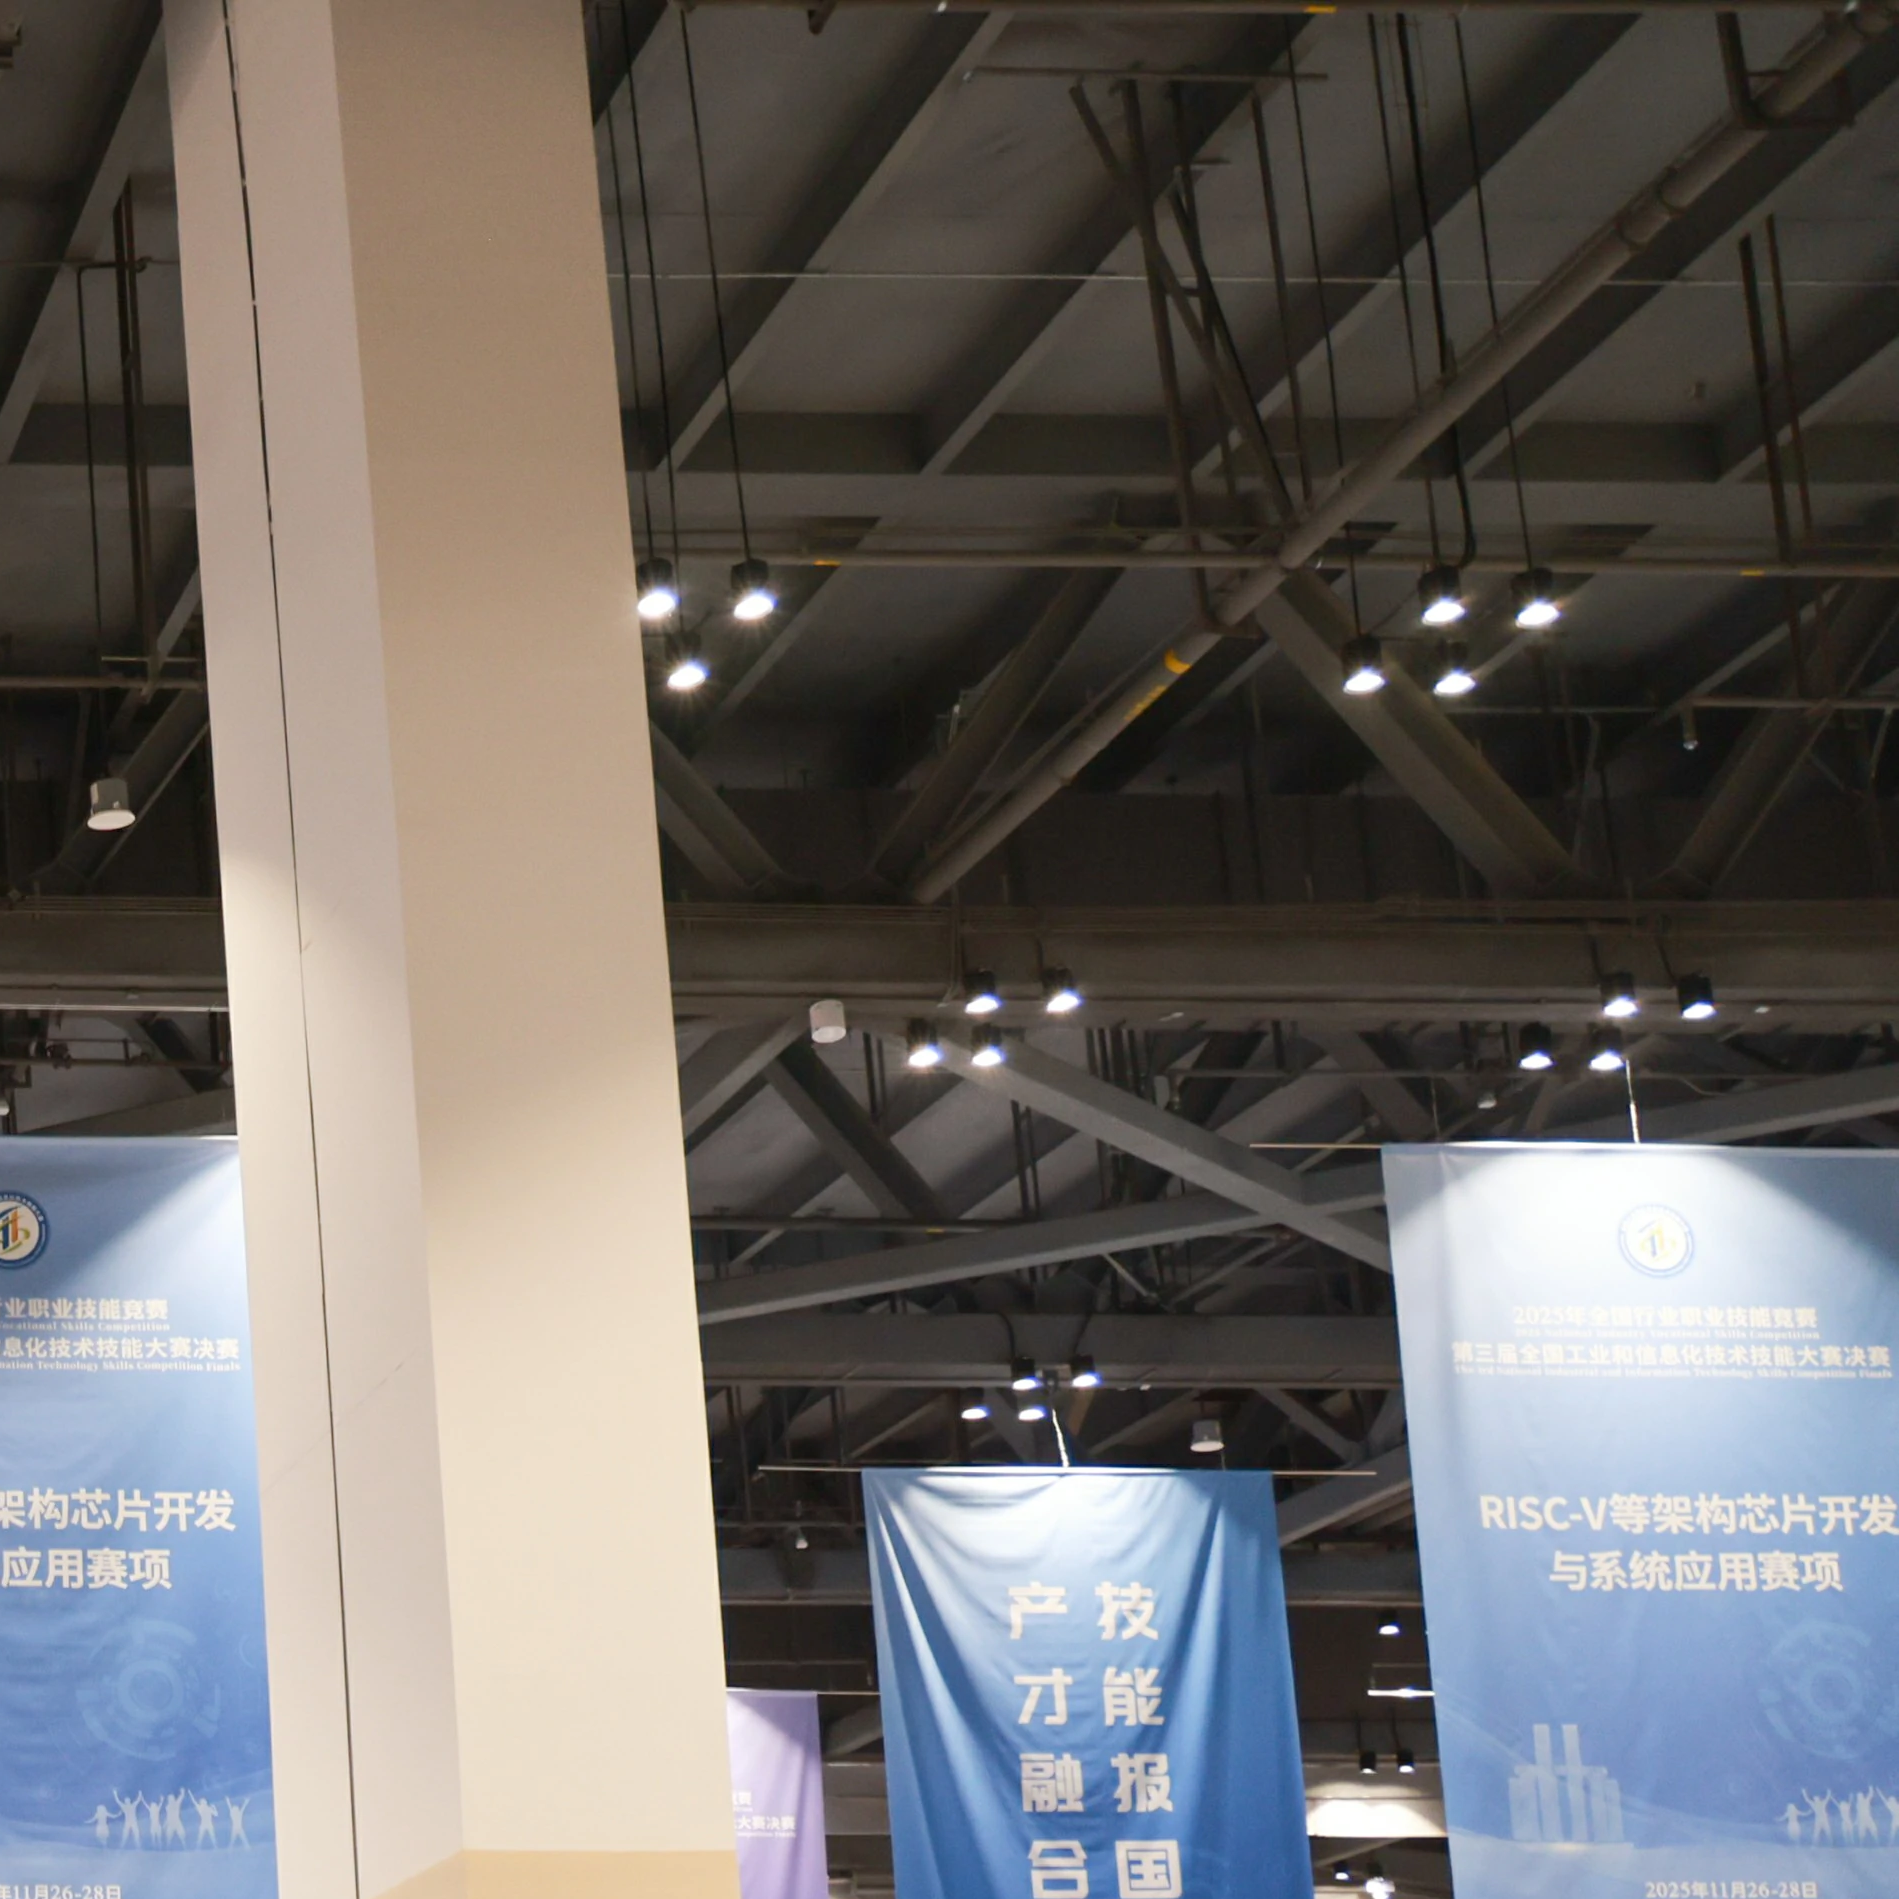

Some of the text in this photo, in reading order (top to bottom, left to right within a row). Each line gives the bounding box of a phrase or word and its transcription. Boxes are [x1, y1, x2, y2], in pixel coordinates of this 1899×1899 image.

[1479, 1493, 1899, 1537] RISC-V等架构芯片开发
[1549, 1550, 1843, 1592] 与系统应用赛项
